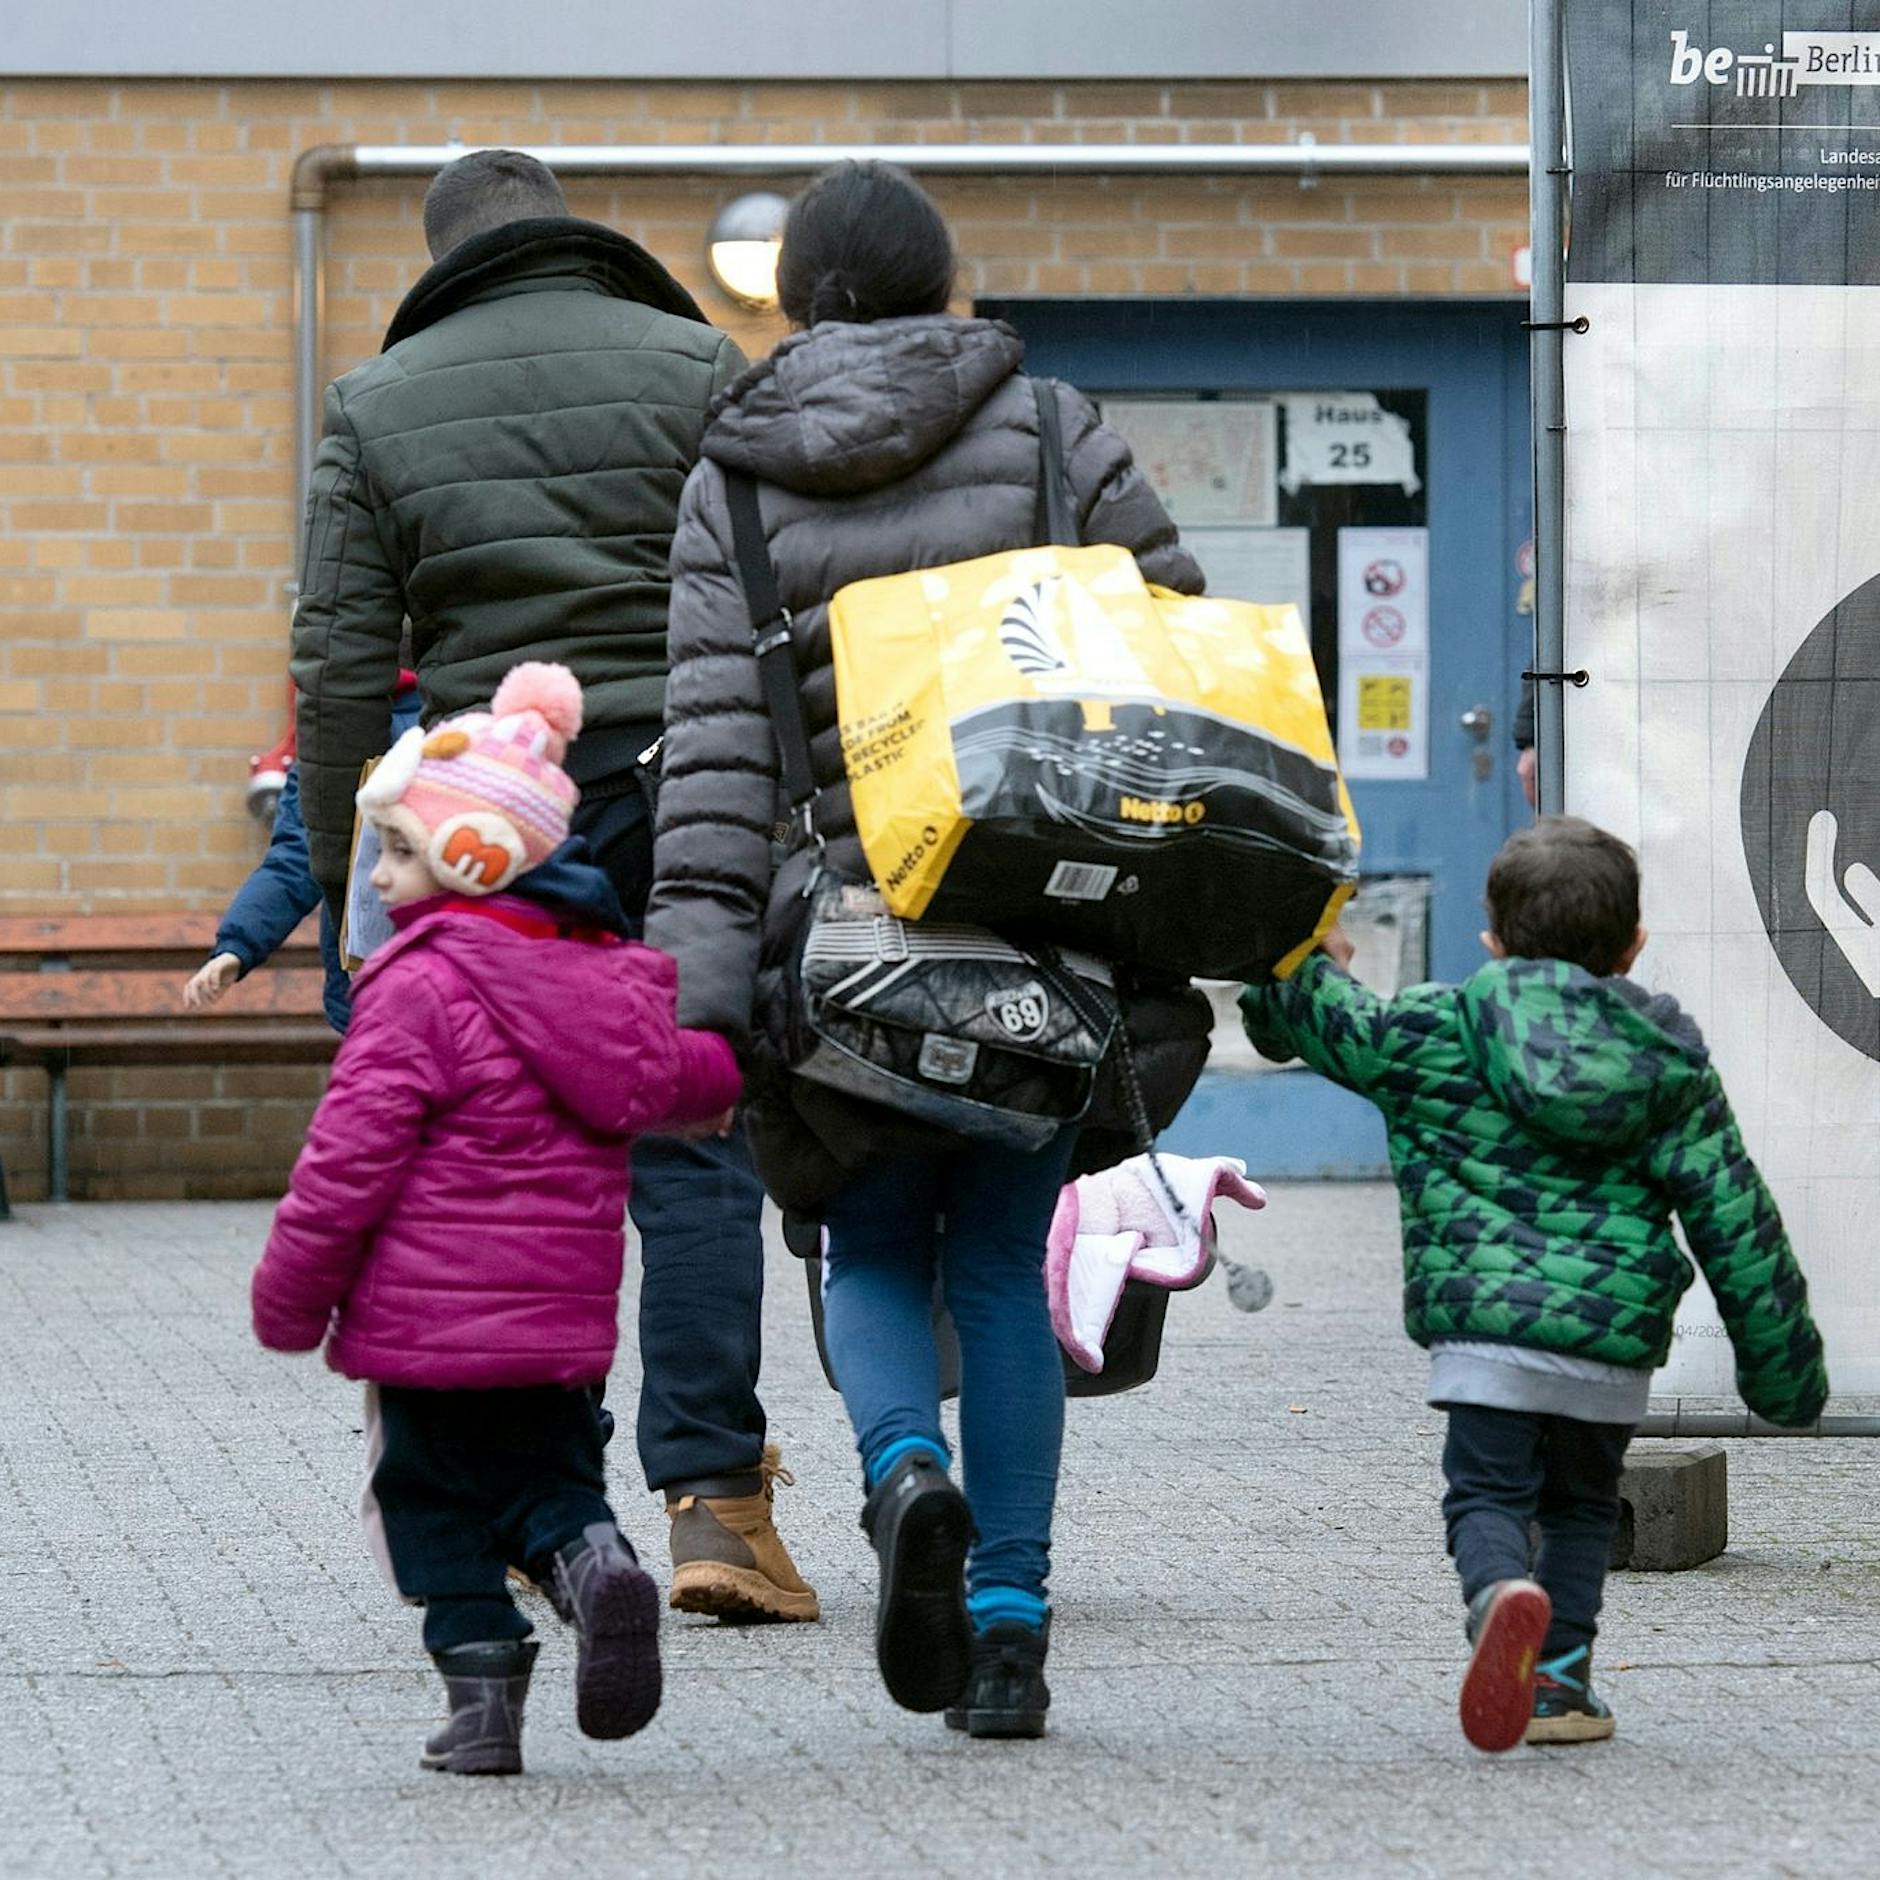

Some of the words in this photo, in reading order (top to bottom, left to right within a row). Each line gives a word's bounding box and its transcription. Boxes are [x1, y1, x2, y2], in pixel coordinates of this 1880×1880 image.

[1669, 29, 1734, 85] be
[1665, 171, 1688, 188] für
[1691, 171, 1880, 193] Flüchtlingsangelegenhei
[1314, 403, 1383, 425] Haus
[1329, 442, 1372, 469] 25
[1120, 796, 1183, 823] Netto
[885, 844, 925, 893] Netto
[1001, 997, 1041, 1033] 69
